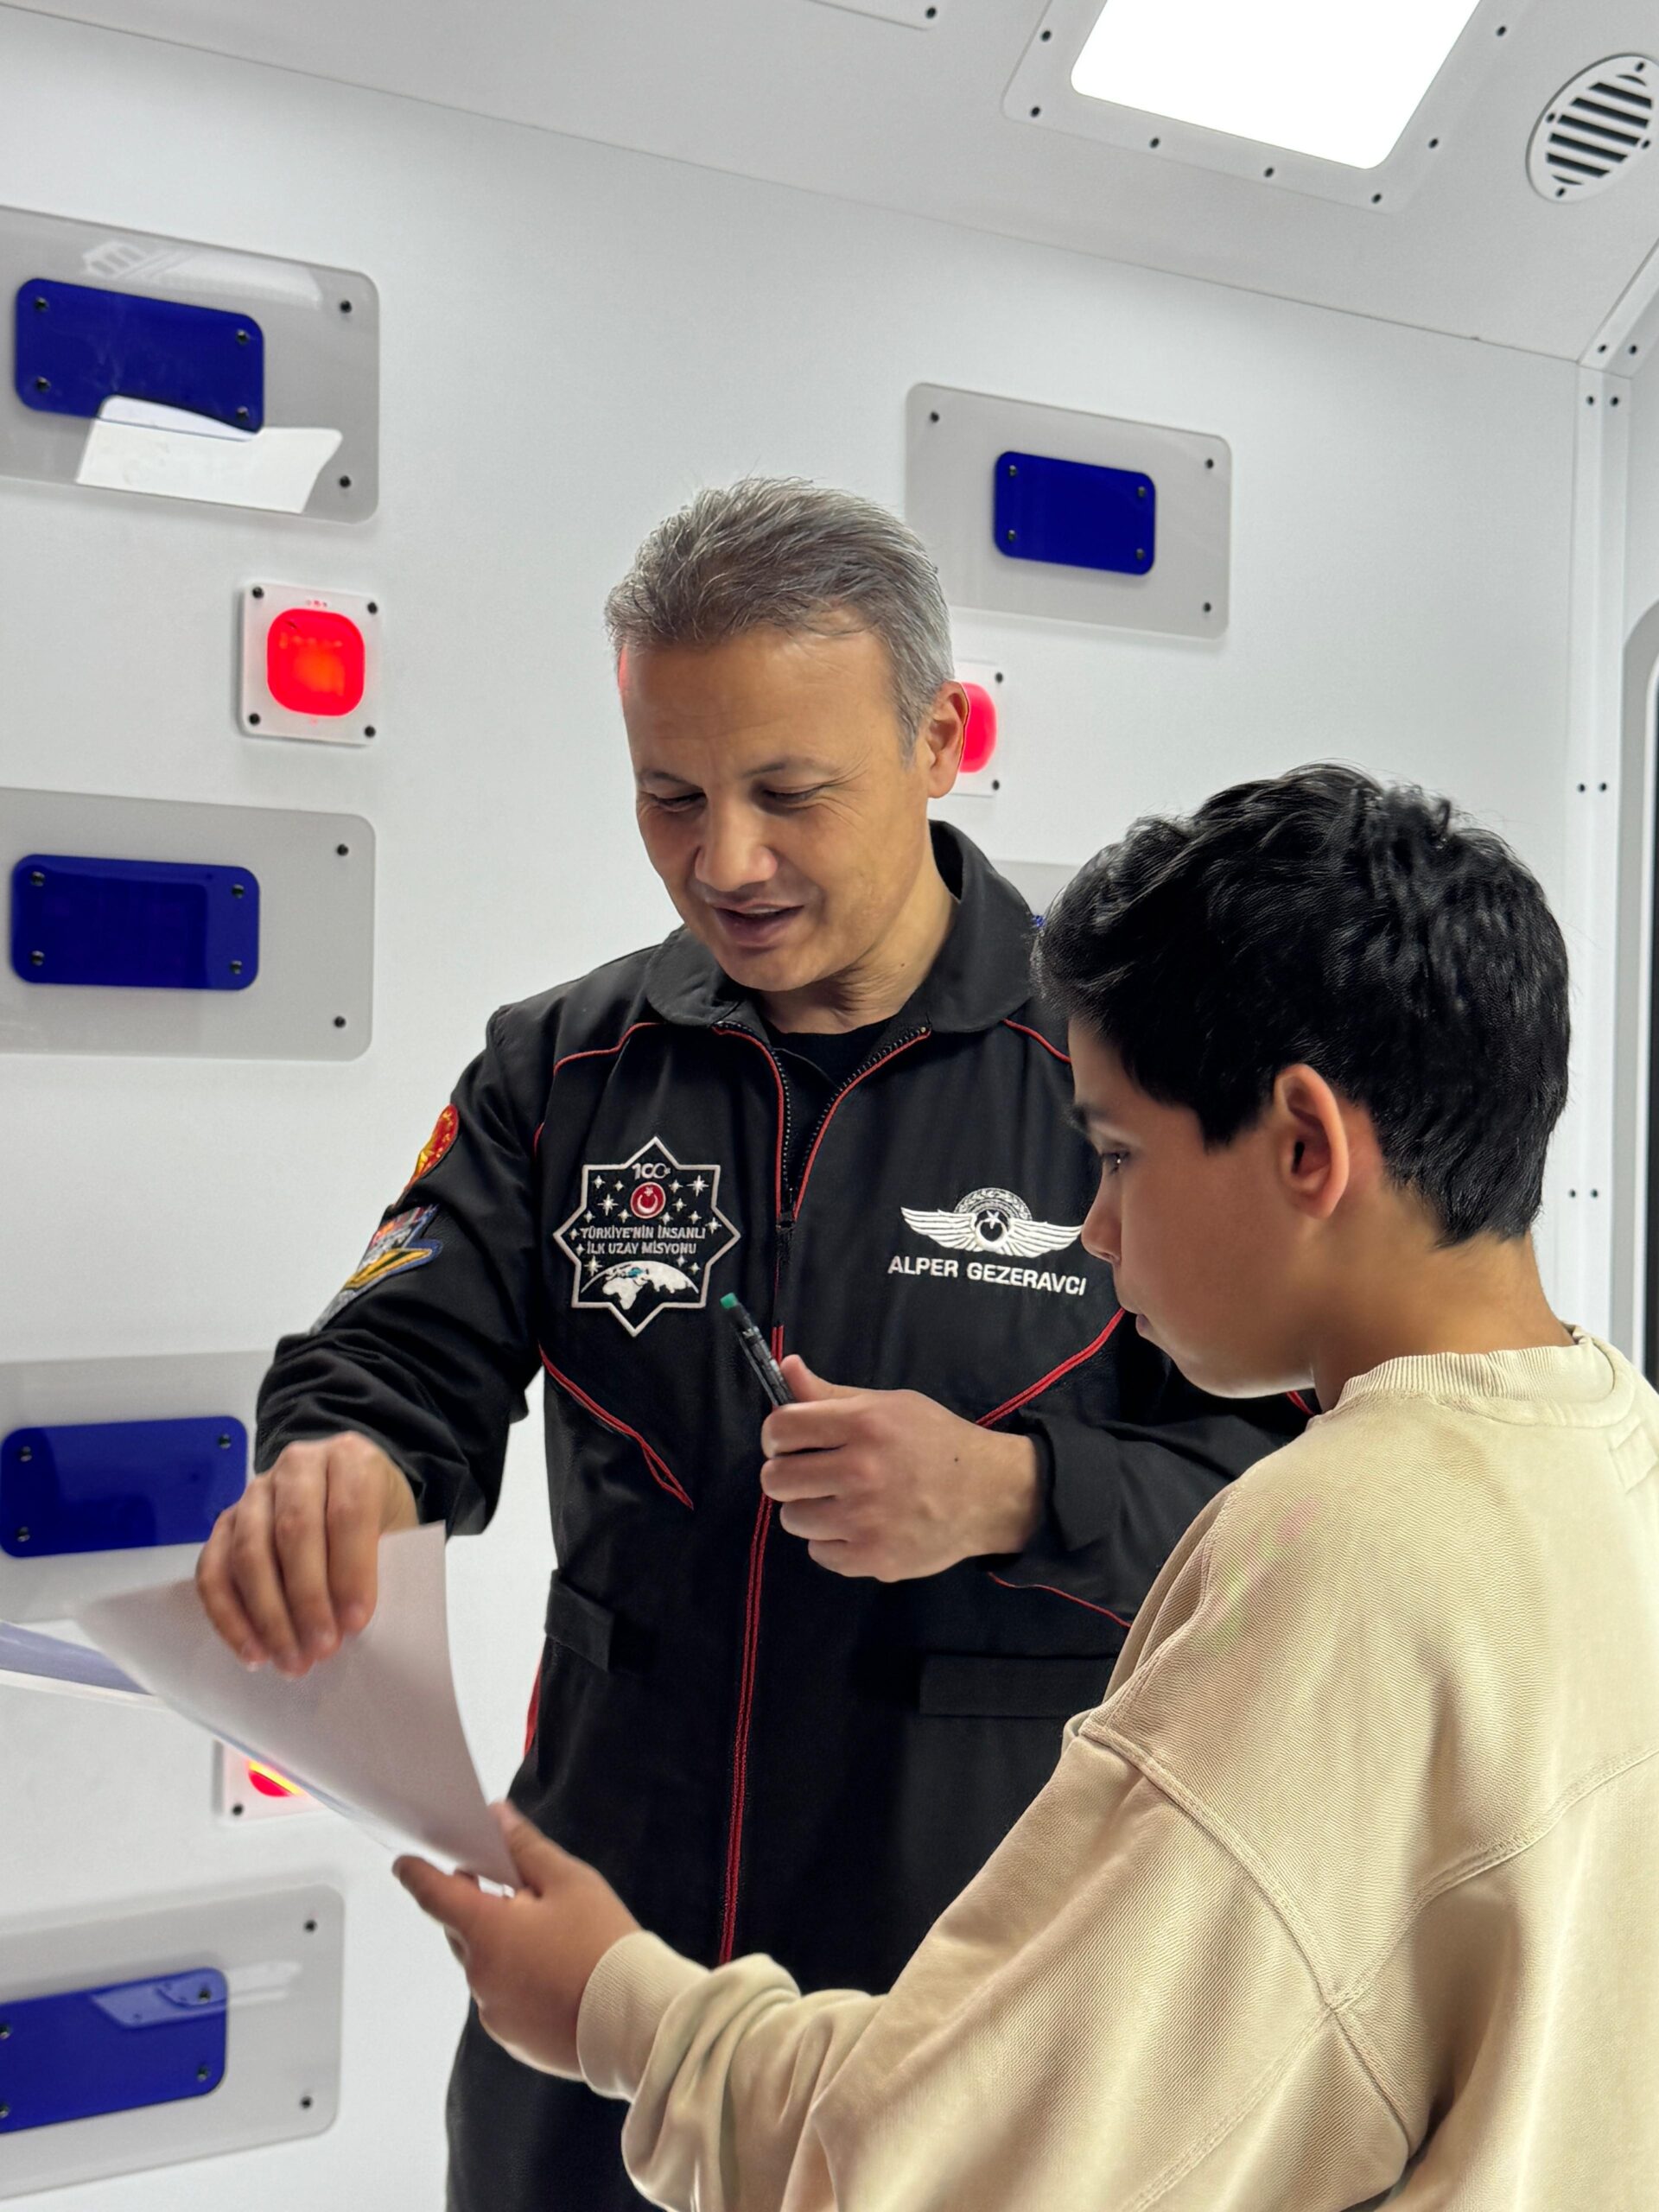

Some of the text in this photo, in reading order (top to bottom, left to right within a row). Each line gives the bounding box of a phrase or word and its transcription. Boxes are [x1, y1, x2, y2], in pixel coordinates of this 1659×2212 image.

[580, 1224, 707, 1239] TÜRKİYE'NİN İNSANLI
[587, 1240, 697, 1254] İLK UZAY MİSYONU
[887, 1255, 1087, 1296] ALPER GEZERAVCI
